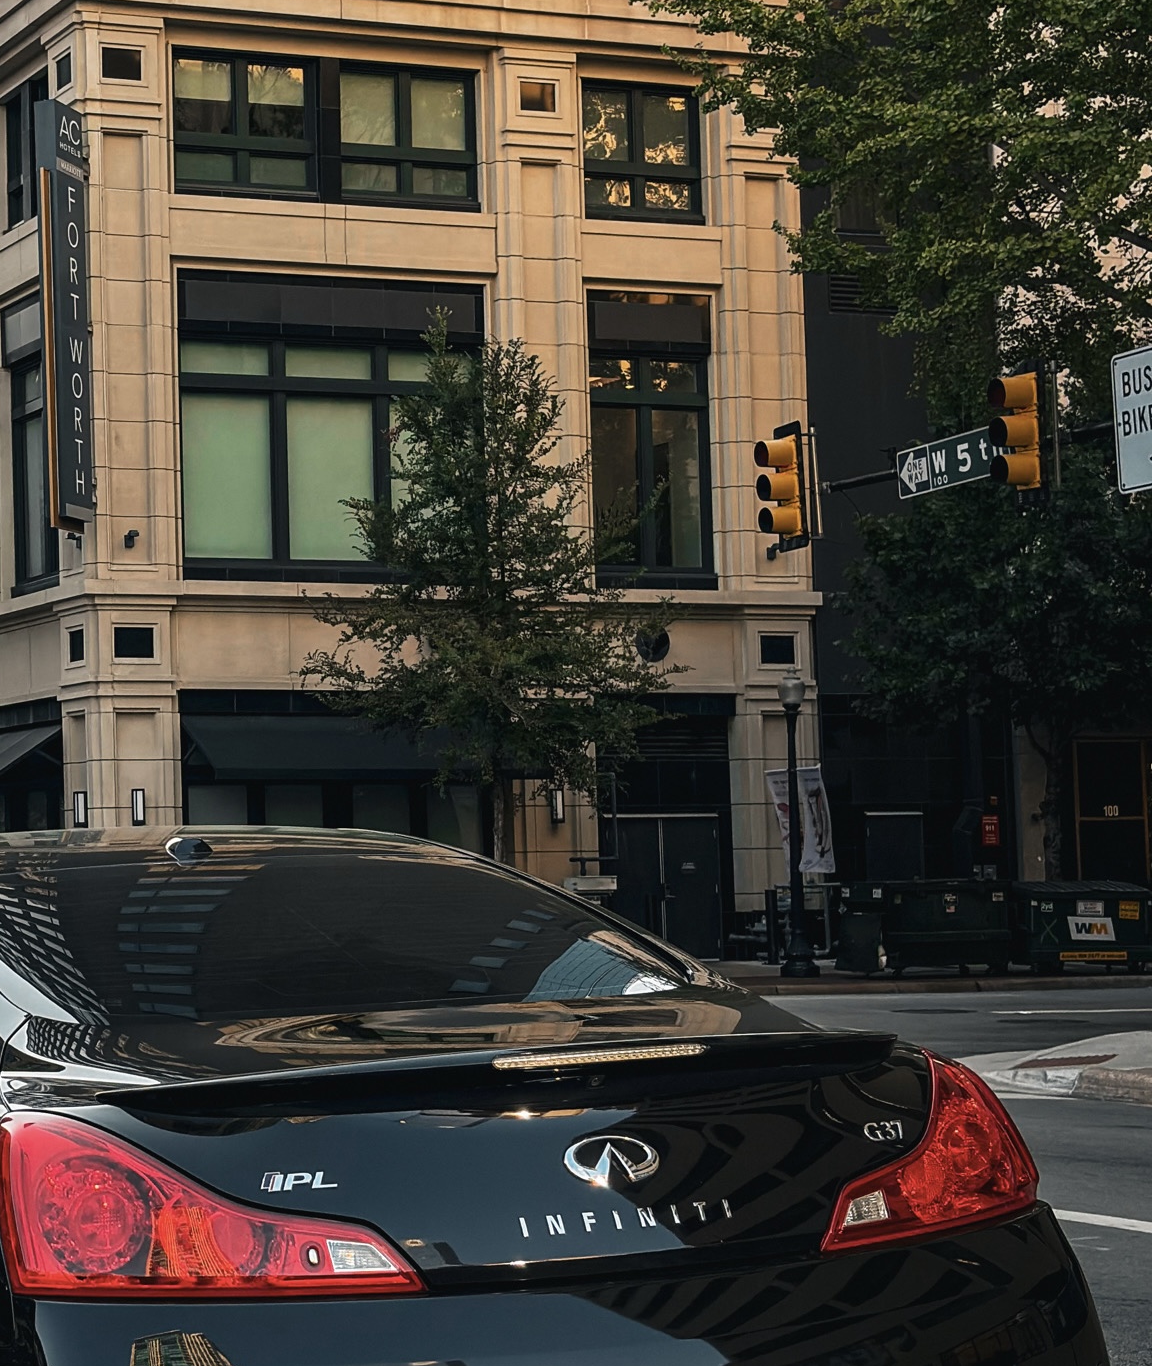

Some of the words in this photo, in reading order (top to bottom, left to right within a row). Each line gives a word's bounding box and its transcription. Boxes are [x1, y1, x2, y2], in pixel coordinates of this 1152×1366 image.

[59, 115, 80, 145] AC
[59, 141, 81, 158] HOTELS
[67, 186, 80, 321] FORT
[69, 336, 85, 495] WORTH
[906, 459, 922, 473] ONE
[931, 448, 946, 474] W
[907, 470, 924, 484] WAY
[933, 474, 948, 486] 100
[1103, 804, 1119, 817] 100
[1074, 922, 1109, 935] WM
[863, 1119, 903, 1142] G37
[260, 1171, 338, 1193] IPL
[519, 1198, 733, 1238] INFINITI
